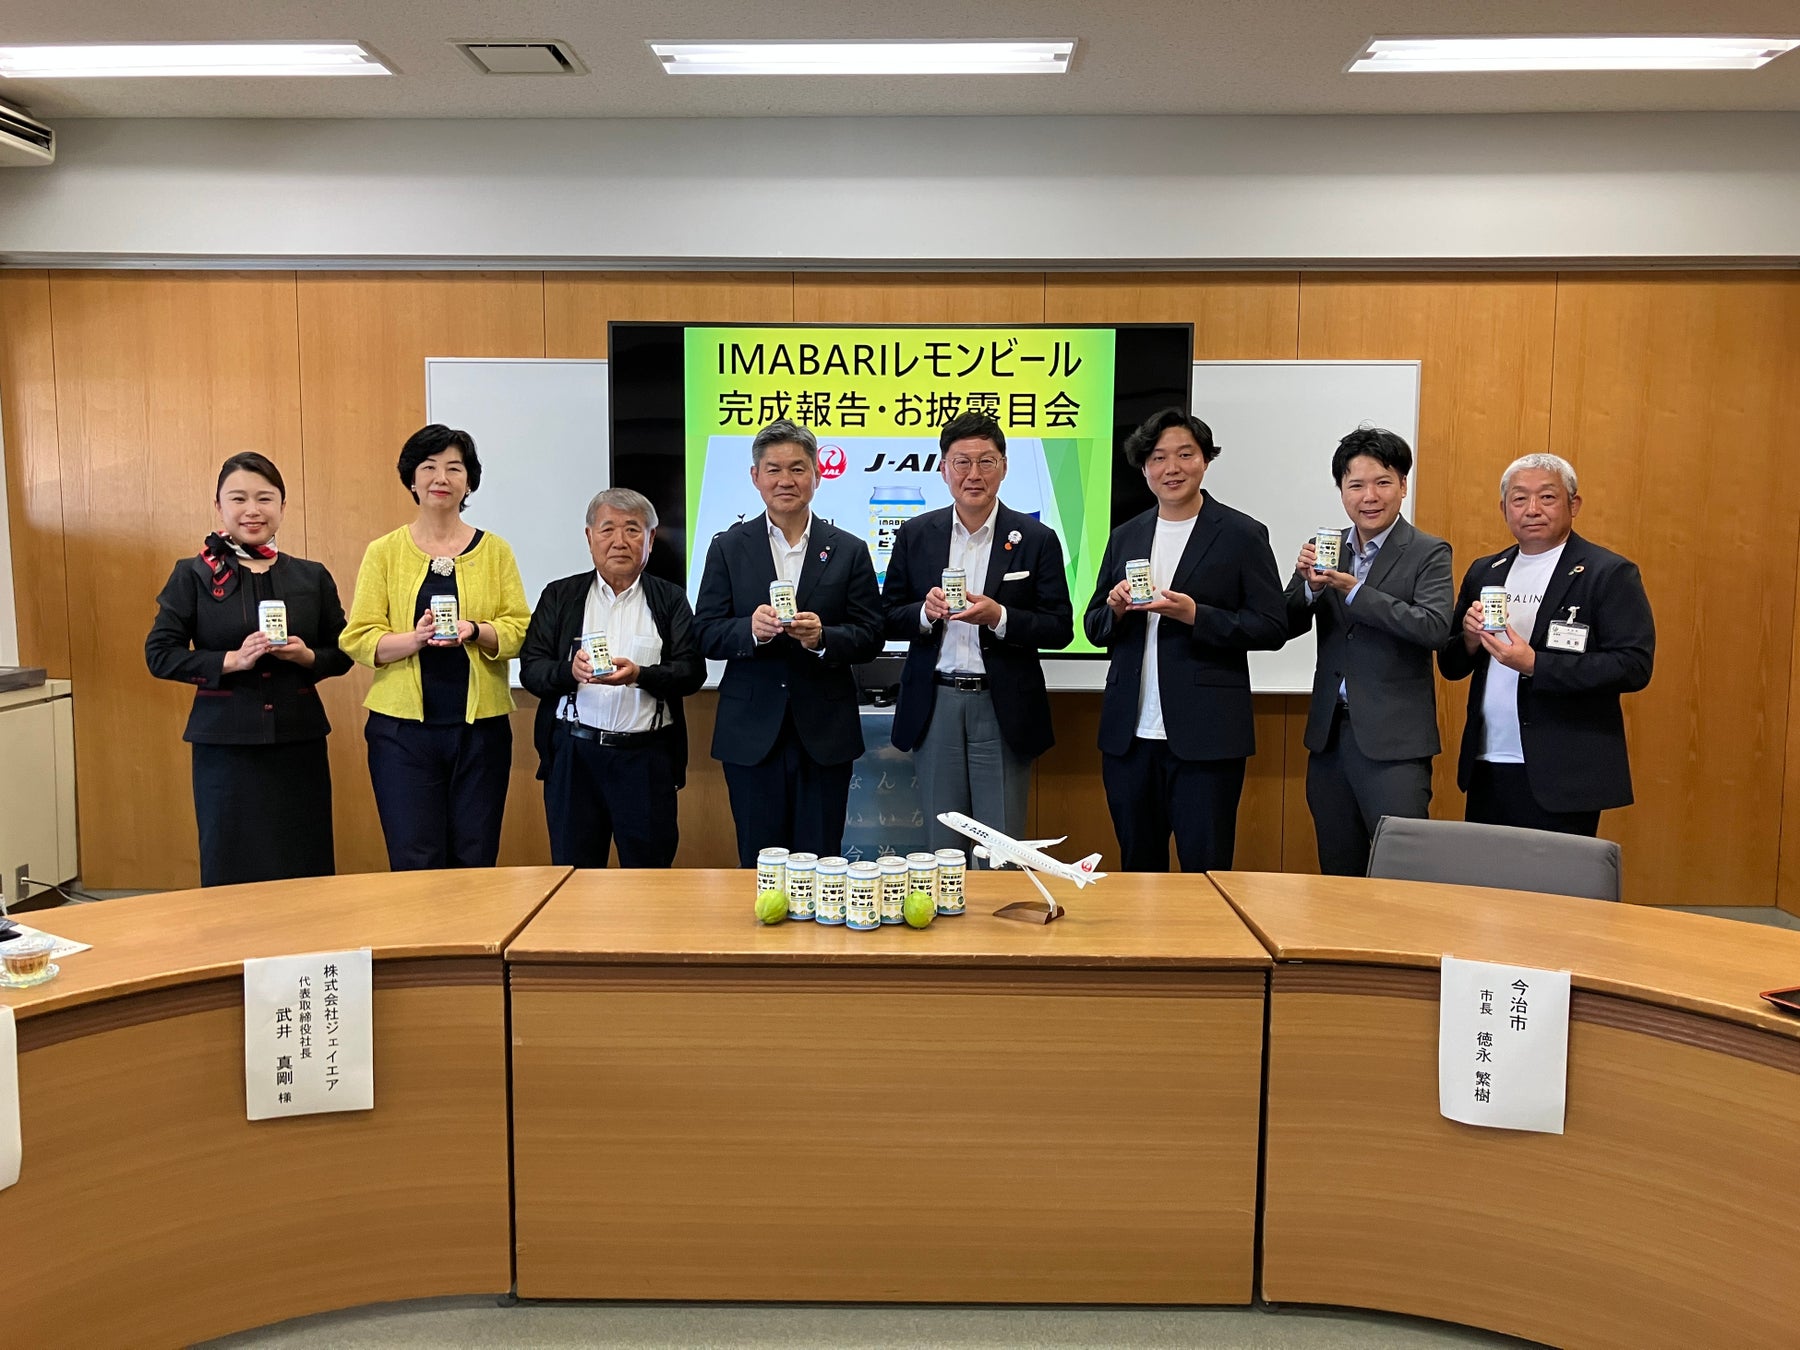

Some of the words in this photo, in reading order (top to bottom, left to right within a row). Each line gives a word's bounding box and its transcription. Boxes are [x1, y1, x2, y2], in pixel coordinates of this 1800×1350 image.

[717, 338, 1083, 378] IMABARIレモンビール
[864, 453, 941, 472] J-AI
[299, 976, 312, 1059] 代表取締役社長
[1479, 989, 1494, 1015] 市長
[1509, 979, 1529, 1031] 今治市
[276, 1007, 292, 1039] 武井
[323, 964, 339, 1091] 株式会社ジェイエア
[1475, 1031, 1493, 1062] 徳永
[277, 1056, 293, 1086] 真剛
[1474, 1070, 1491, 1103] 繁樹
[278, 1092, 292, 1104] 様
